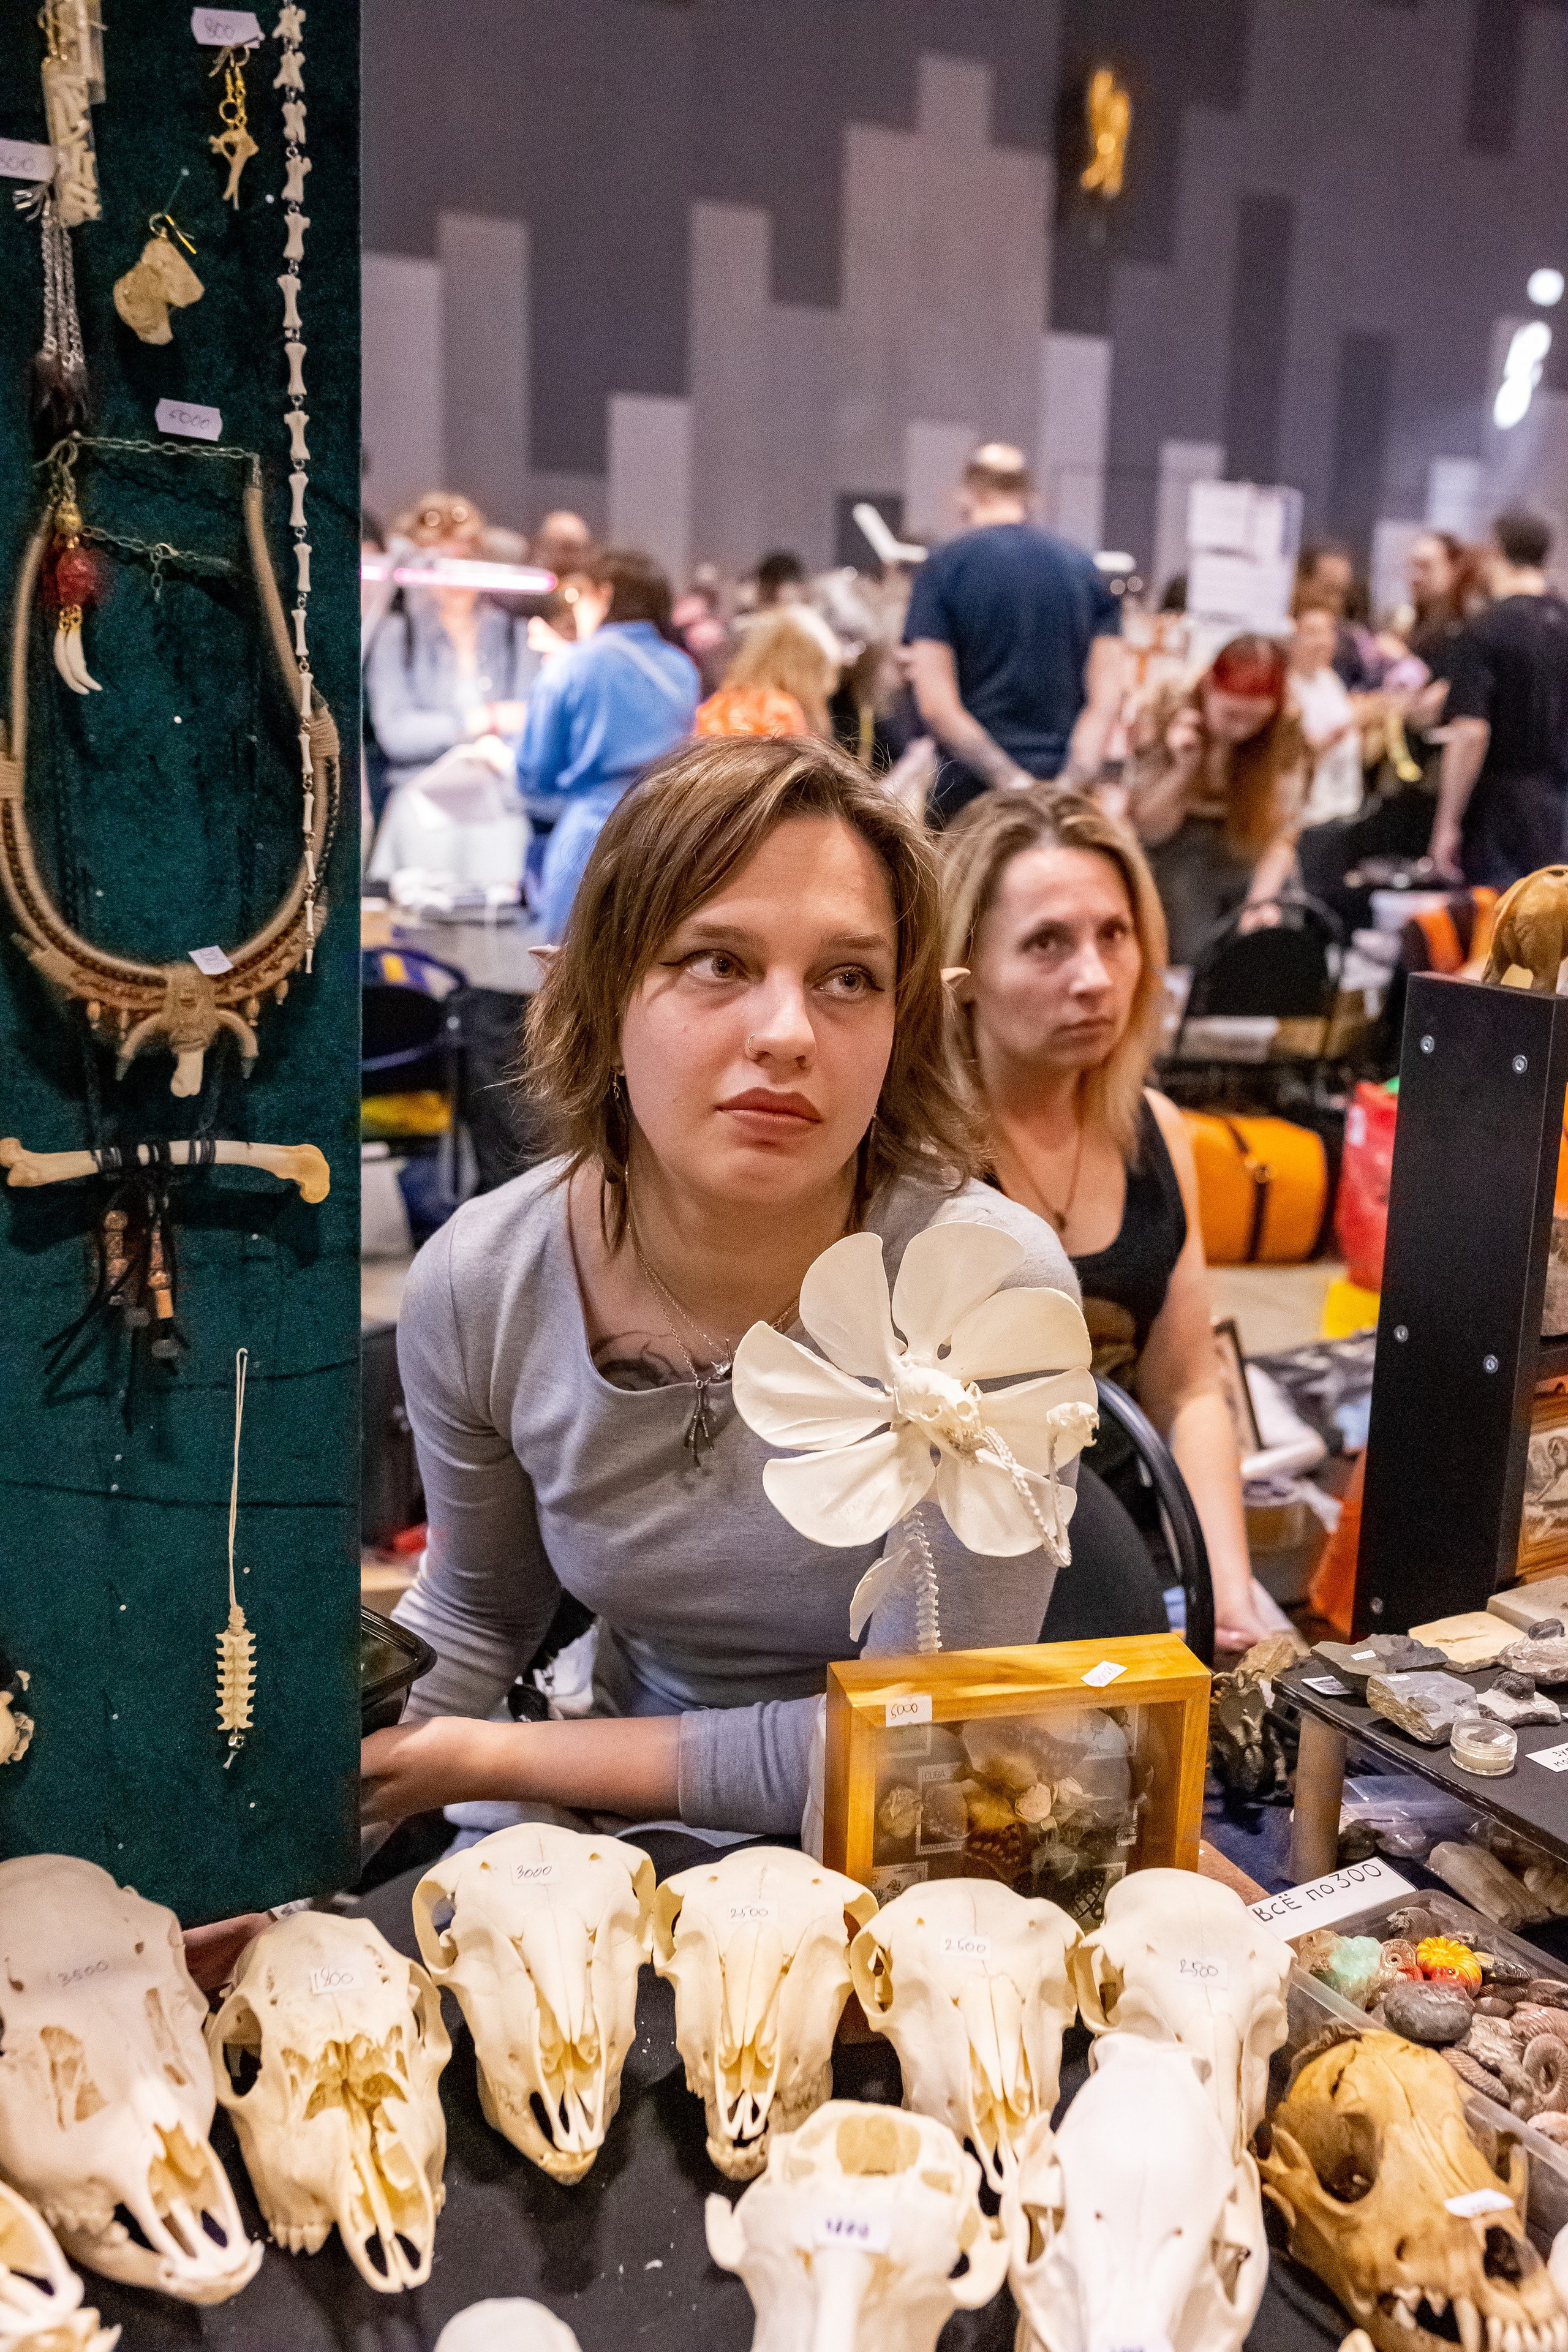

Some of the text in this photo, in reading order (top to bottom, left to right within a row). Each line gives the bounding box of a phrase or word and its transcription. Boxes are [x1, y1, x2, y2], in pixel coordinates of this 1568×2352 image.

[924, 1770, 946, 1780] CUBA
[517, 1864, 552, 1879] 3000
[730, 1904, 768, 1918] 2500
[1252, 1893, 1302, 1922] ВСЁ
[945, 1937, 986, 1953] 2500
[57, 1961, 109, 1986] 3500
[1180, 1958, 1218, 1977] 2500
